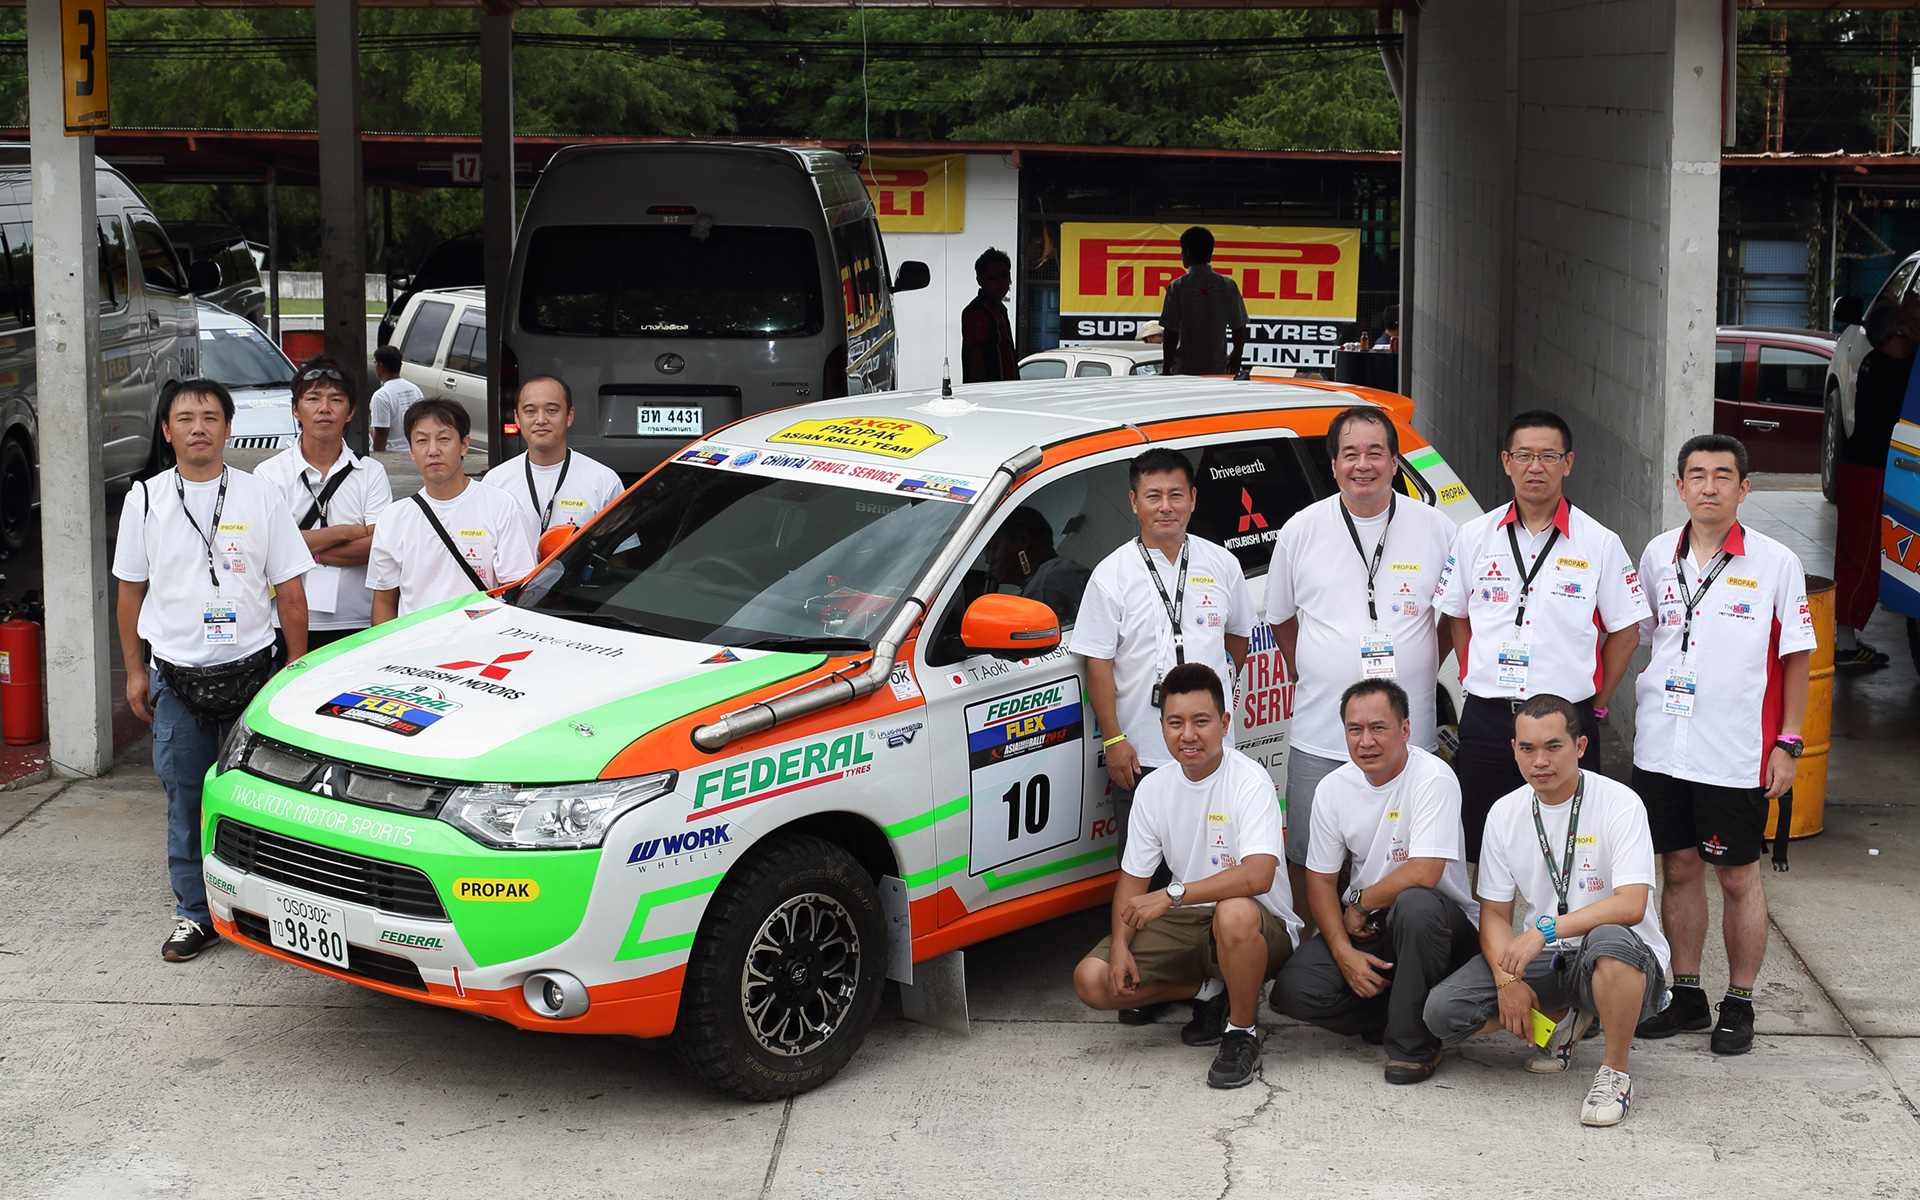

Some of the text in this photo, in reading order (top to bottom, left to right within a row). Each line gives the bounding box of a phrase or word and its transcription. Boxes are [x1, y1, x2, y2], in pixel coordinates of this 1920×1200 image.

[76, 9, 95, 96] 3
[455, 157, 477, 178] 17
[1078, 238, 1341, 301] PIRLLI
[1249, 323, 1338, 341] TYRES
[180, 347, 196, 377] 309
[668, 409, 700, 424] 4431
[844, 417, 912, 433] AXCR
[779, 432, 914, 455] ASIAN RALLY TEAM
[820, 424, 903, 442] PROPAK
[806, 458, 850, 477] TRAVEL
[848, 466, 902, 484] SERVICE
[919, 474, 972, 487] FEDERAL
[1209, 459, 1266, 480] Drive@earth
[1441, 485, 1467, 501] PROPAK
[1223, 533, 1261, 550] MITSUBISHI
[1559, 558, 1586, 568] PROPAK
[1728, 577, 1756, 588] PROPAK
[496, 626, 625, 660] Drive@earth
[890, 669, 911, 685] OK
[967, 659, 1009, 683] T.Aoki
[376, 664, 527, 701] MITSUBISHI MOTORS
[354, 697, 415, 718] FLEX
[357, 685, 455, 711] FEDERAL
[986, 686, 1063, 722] FEDERAL
[1005, 714, 1046, 741] FLEX
[1045, 728, 1067, 743] 2013
[887, 730, 917, 749] EV
[692, 731, 874, 810] FEDERAL
[845, 763, 872, 779] TYRES
[1002, 773, 1051, 842] 10
[296, 803, 348, 832] MOTOR
[349, 816, 416, 846] SPORTS
[205, 871, 238, 896] FEDERAL
[461, 881, 530, 898] PROPAK
[283, 897, 329, 925] OSO302
[285, 917, 344, 962] 98-80
[380, 929, 444, 949] FEDERAL
[745, 1052, 823, 1082] FEDERAL
